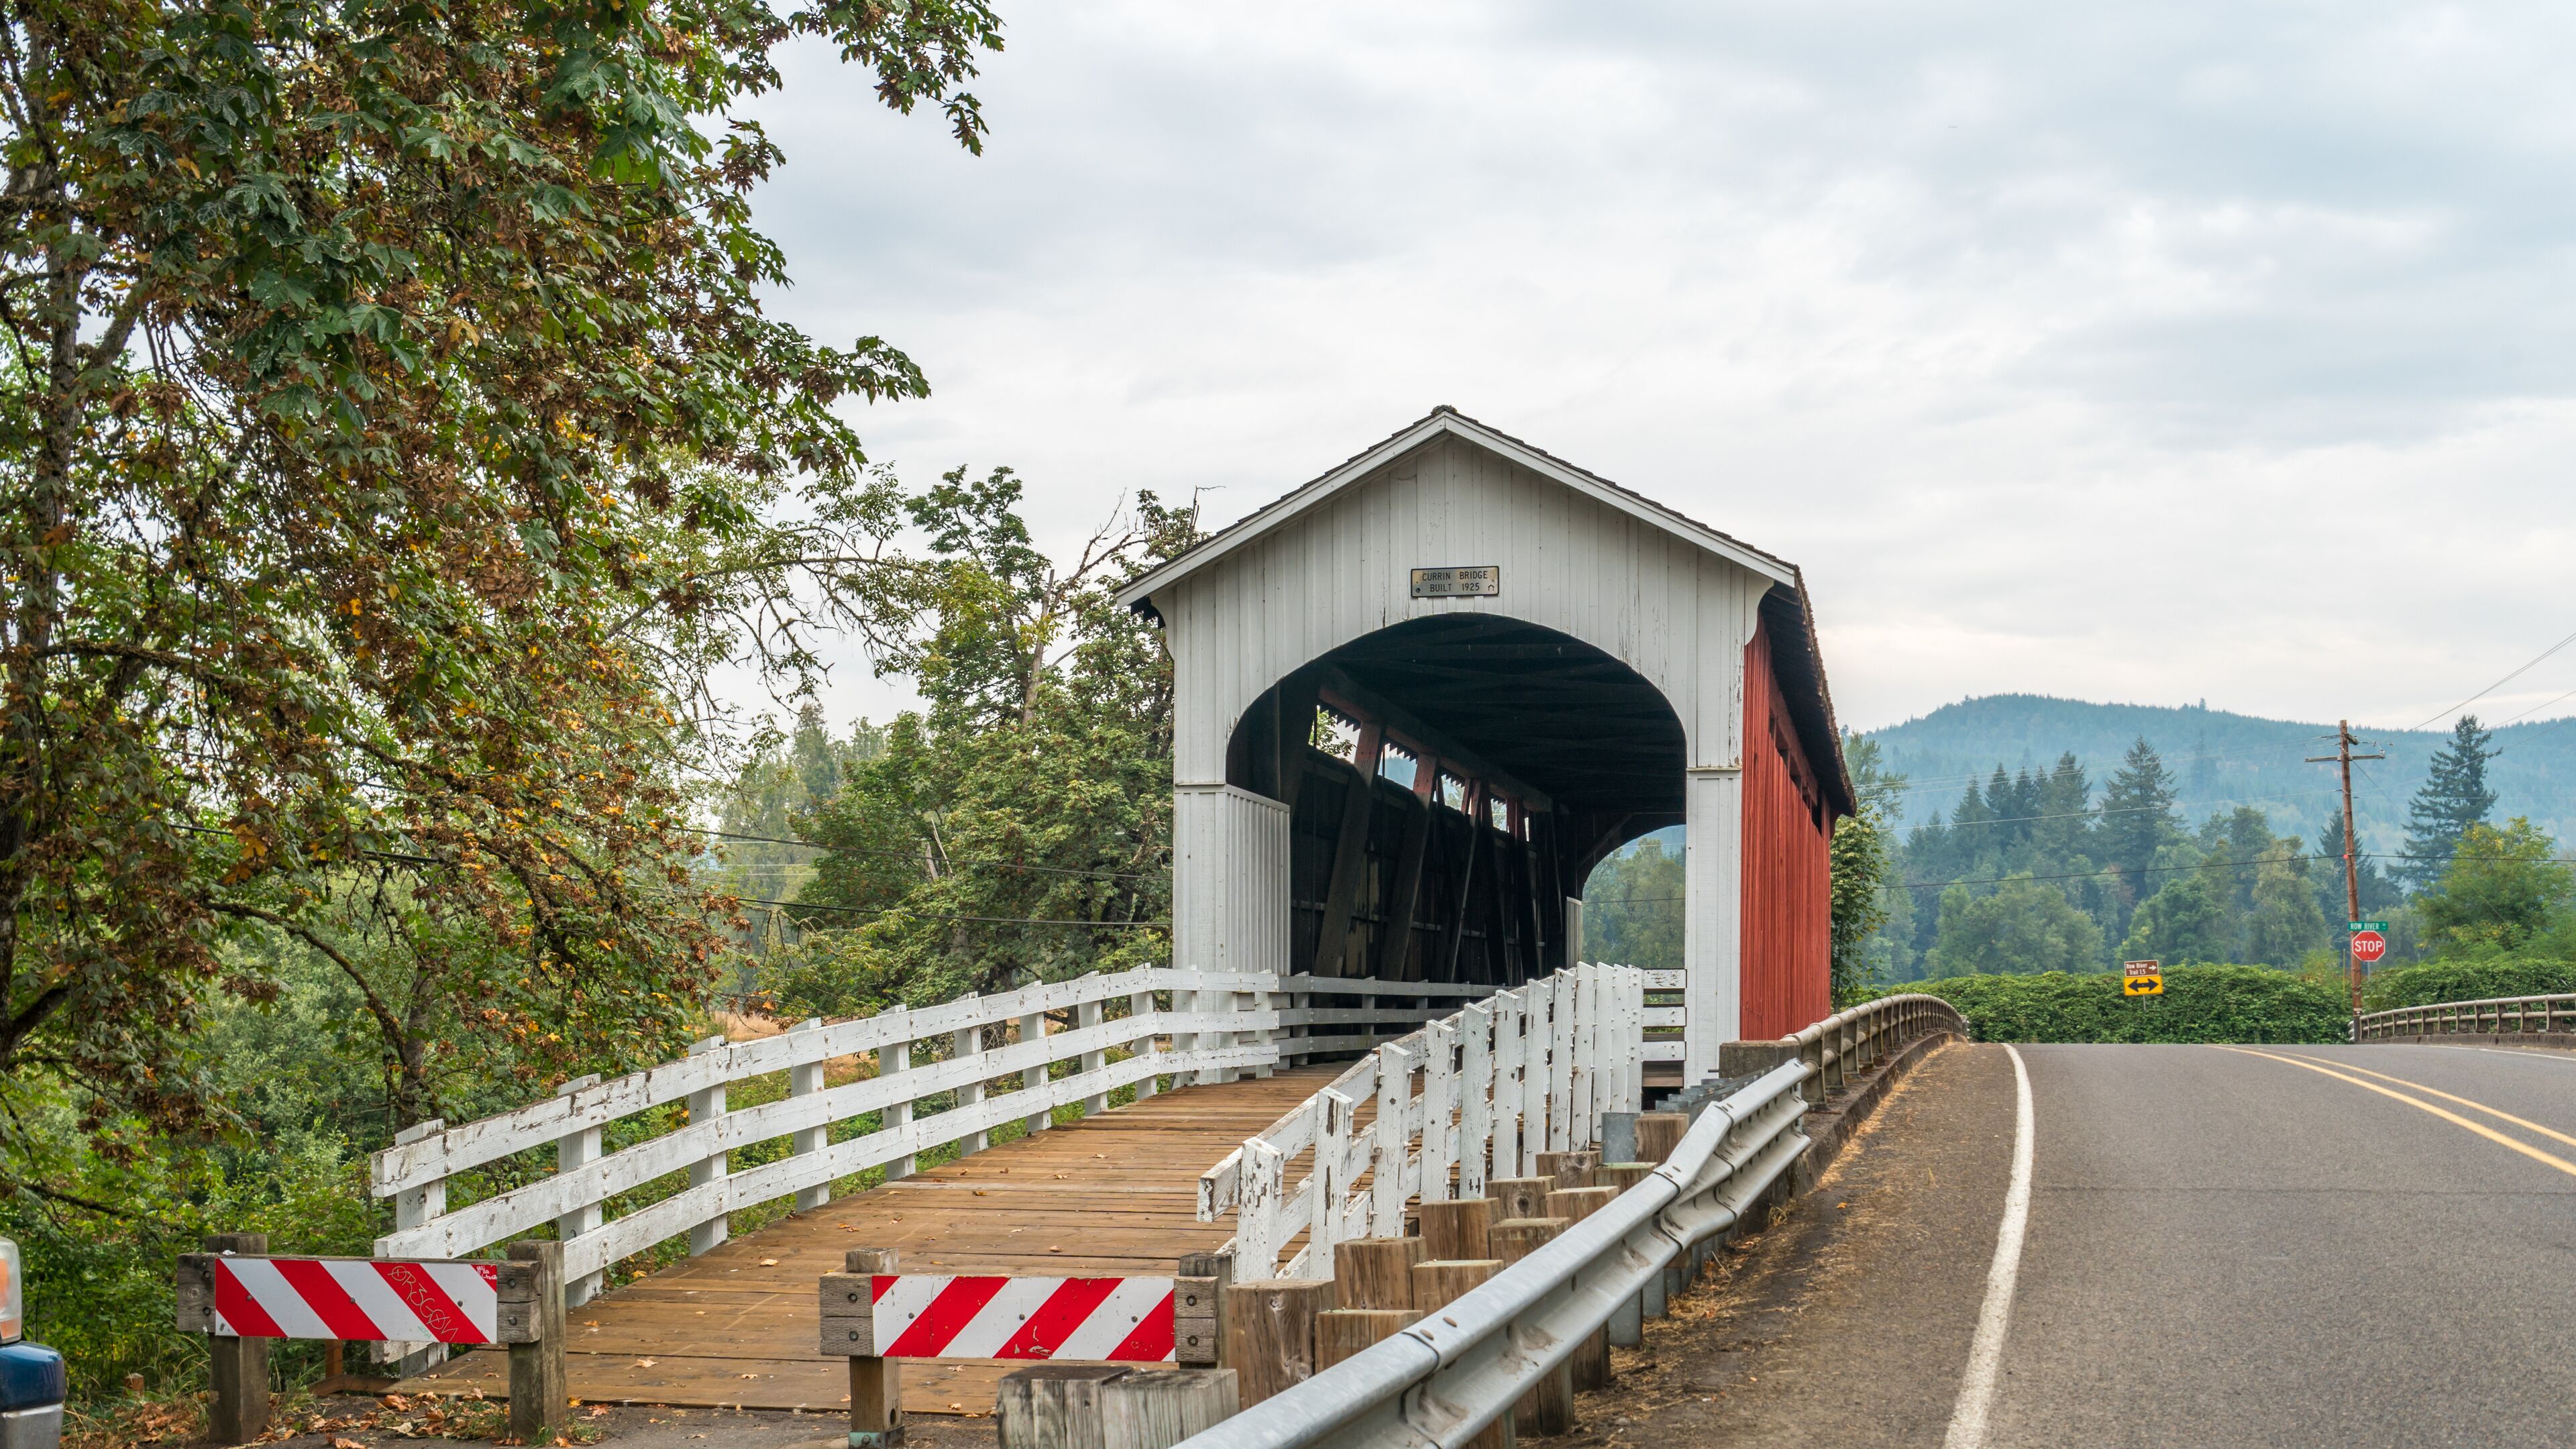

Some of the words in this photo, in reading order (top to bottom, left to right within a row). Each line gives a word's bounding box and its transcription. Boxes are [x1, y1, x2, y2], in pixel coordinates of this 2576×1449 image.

[1422, 572, 1451, 581] CURRIN
[1459, 570, 1488, 580] BRIDGE
[1430, 583, 1452, 592] BUILT
[1462, 582, 1480, 591] 1925
[2355, 941, 2383, 952] STOP
